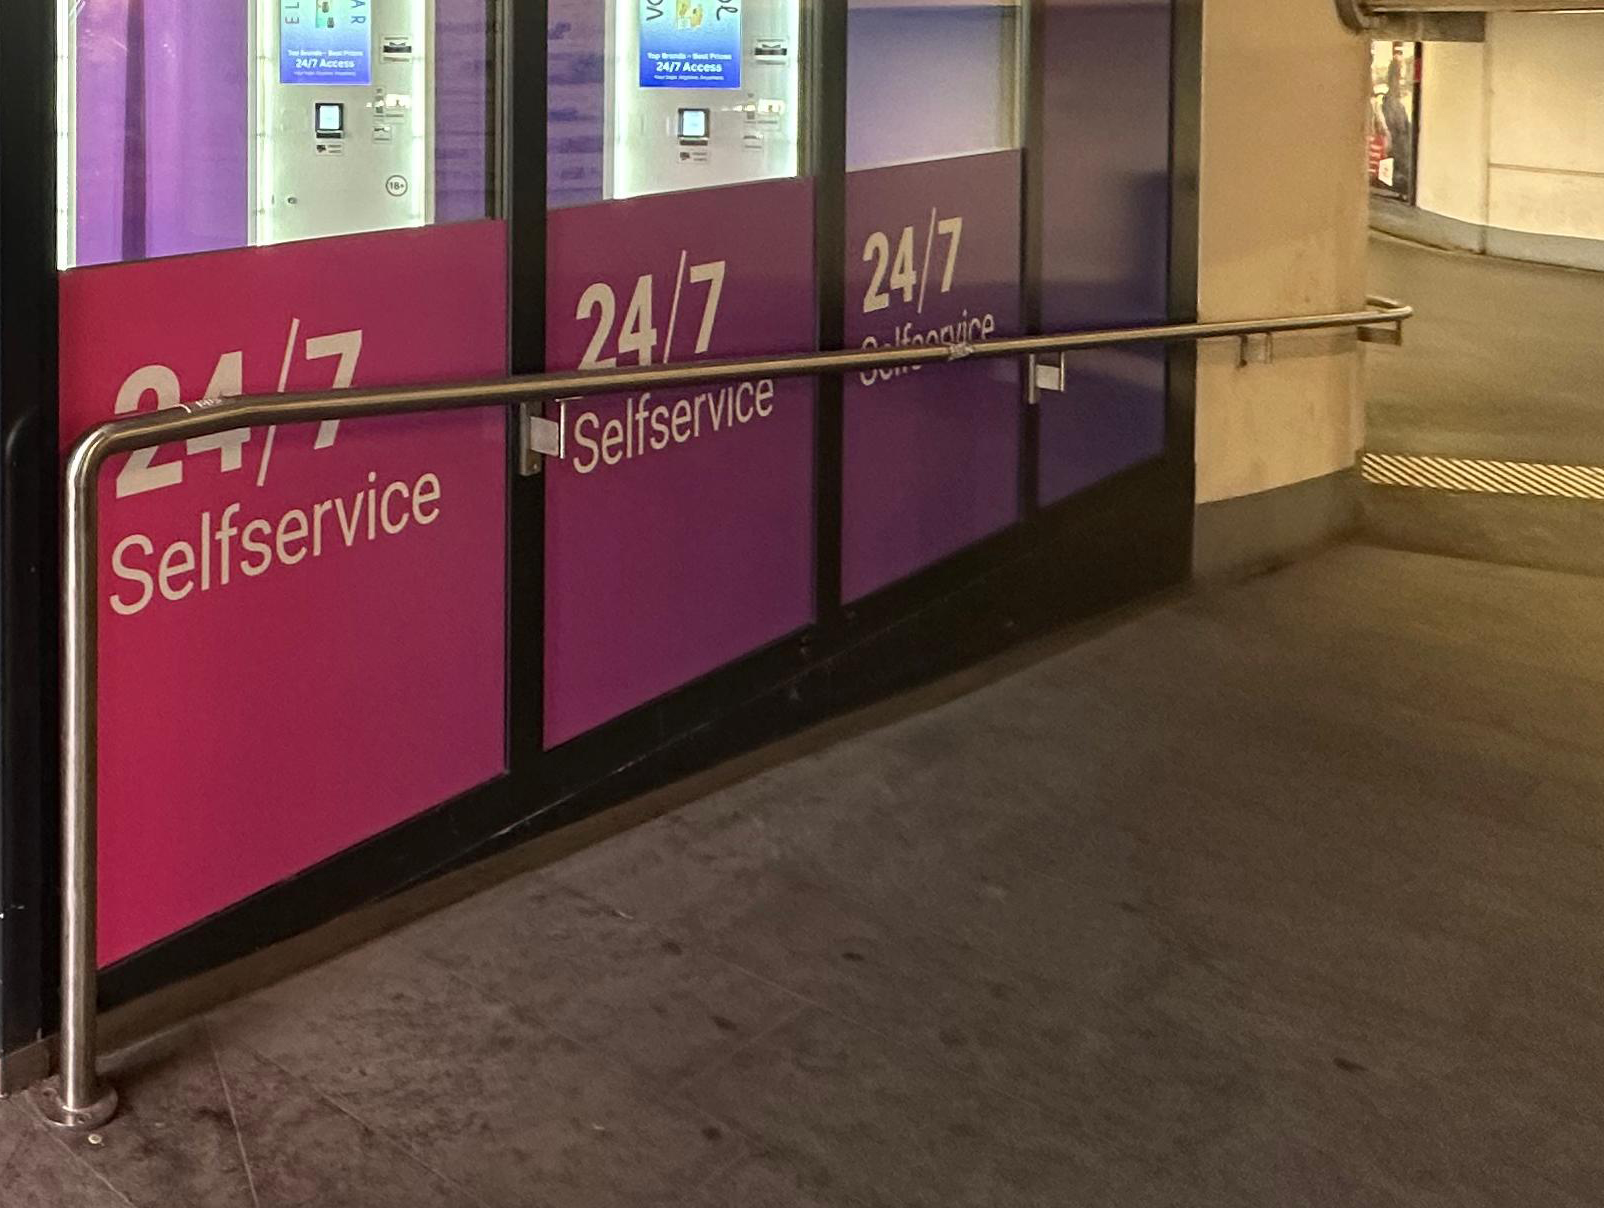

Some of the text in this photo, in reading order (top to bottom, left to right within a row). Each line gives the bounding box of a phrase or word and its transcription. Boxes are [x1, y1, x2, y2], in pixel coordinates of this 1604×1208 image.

[295, 58, 356, 68] 24/7 Access
[656, 61, 723, 72] 24/7 Access
[575, 249, 727, 371] 24/7
[861, 207, 963, 315] 24/7
[113, 317, 364, 499] 24/7
[572, 378, 775, 474] Selfservice
[109, 471, 441, 615] Selfservice
